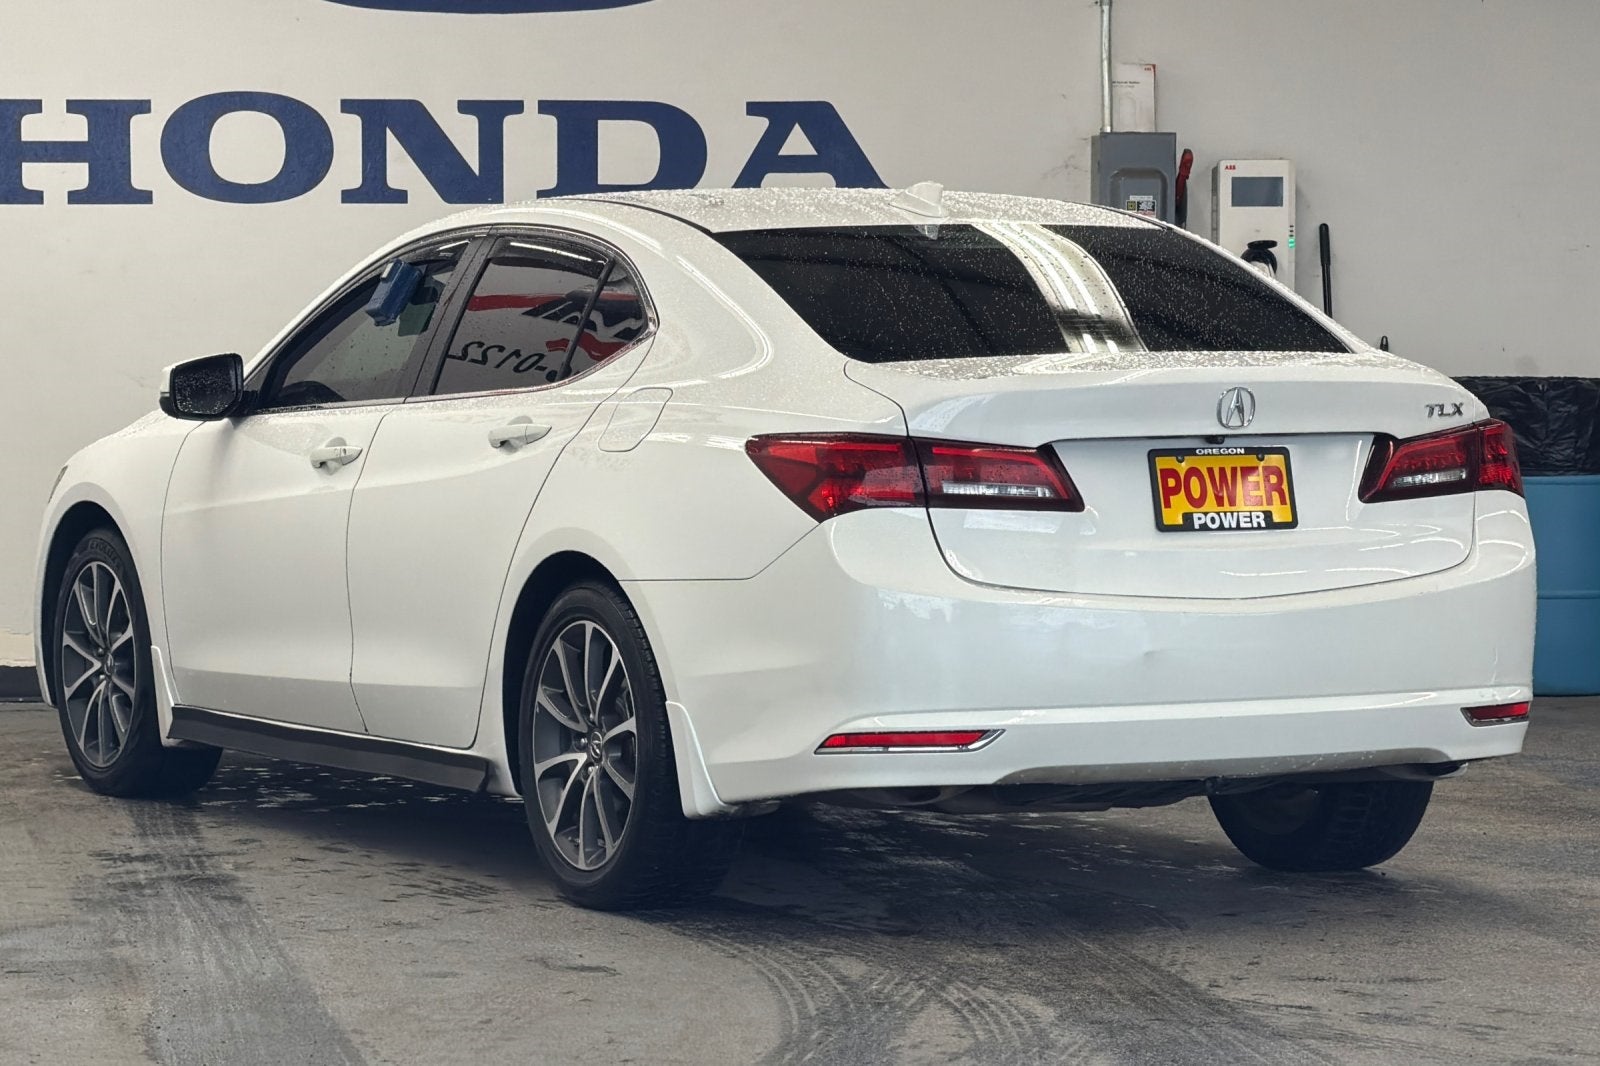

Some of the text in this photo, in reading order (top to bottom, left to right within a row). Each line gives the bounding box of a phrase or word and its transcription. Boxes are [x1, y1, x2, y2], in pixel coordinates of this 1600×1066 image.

[0, 91, 889, 205] HONDA
[1424, 402, 1464, 418] TLX
[1195, 447, 1245, 455] OREGON
[1159, 465, 1288, 509] POWER
[1192, 511, 1266, 529] POWER
